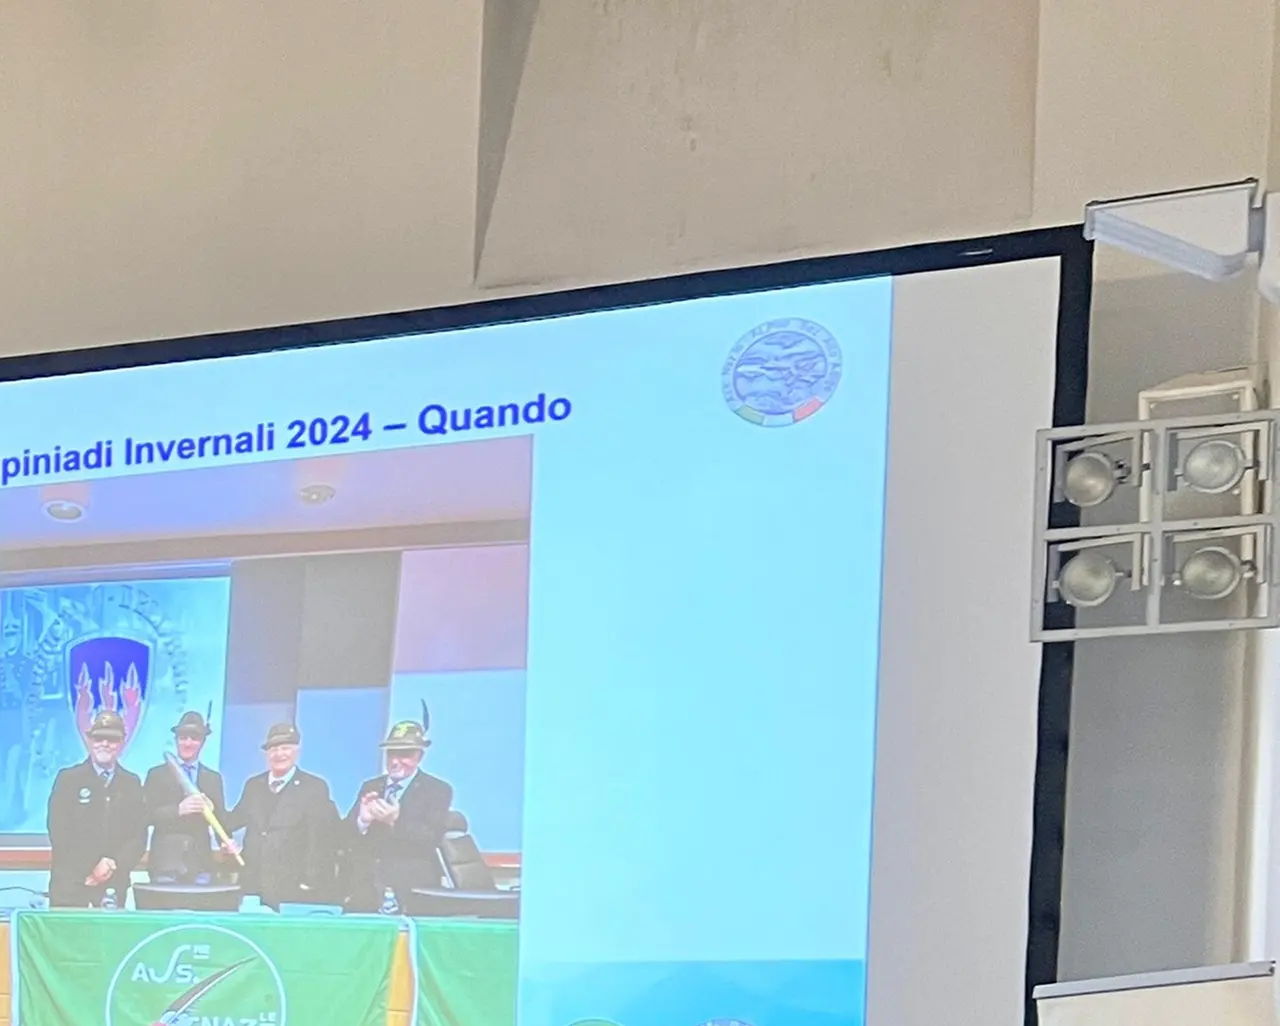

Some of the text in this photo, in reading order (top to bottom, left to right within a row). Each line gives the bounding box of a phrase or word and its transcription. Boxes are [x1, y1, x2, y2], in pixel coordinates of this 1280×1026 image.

[124, 422, 276, 467] Invernali
[286, 412, 373, 449] 2024
[417, 394, 572, 436] Quando
